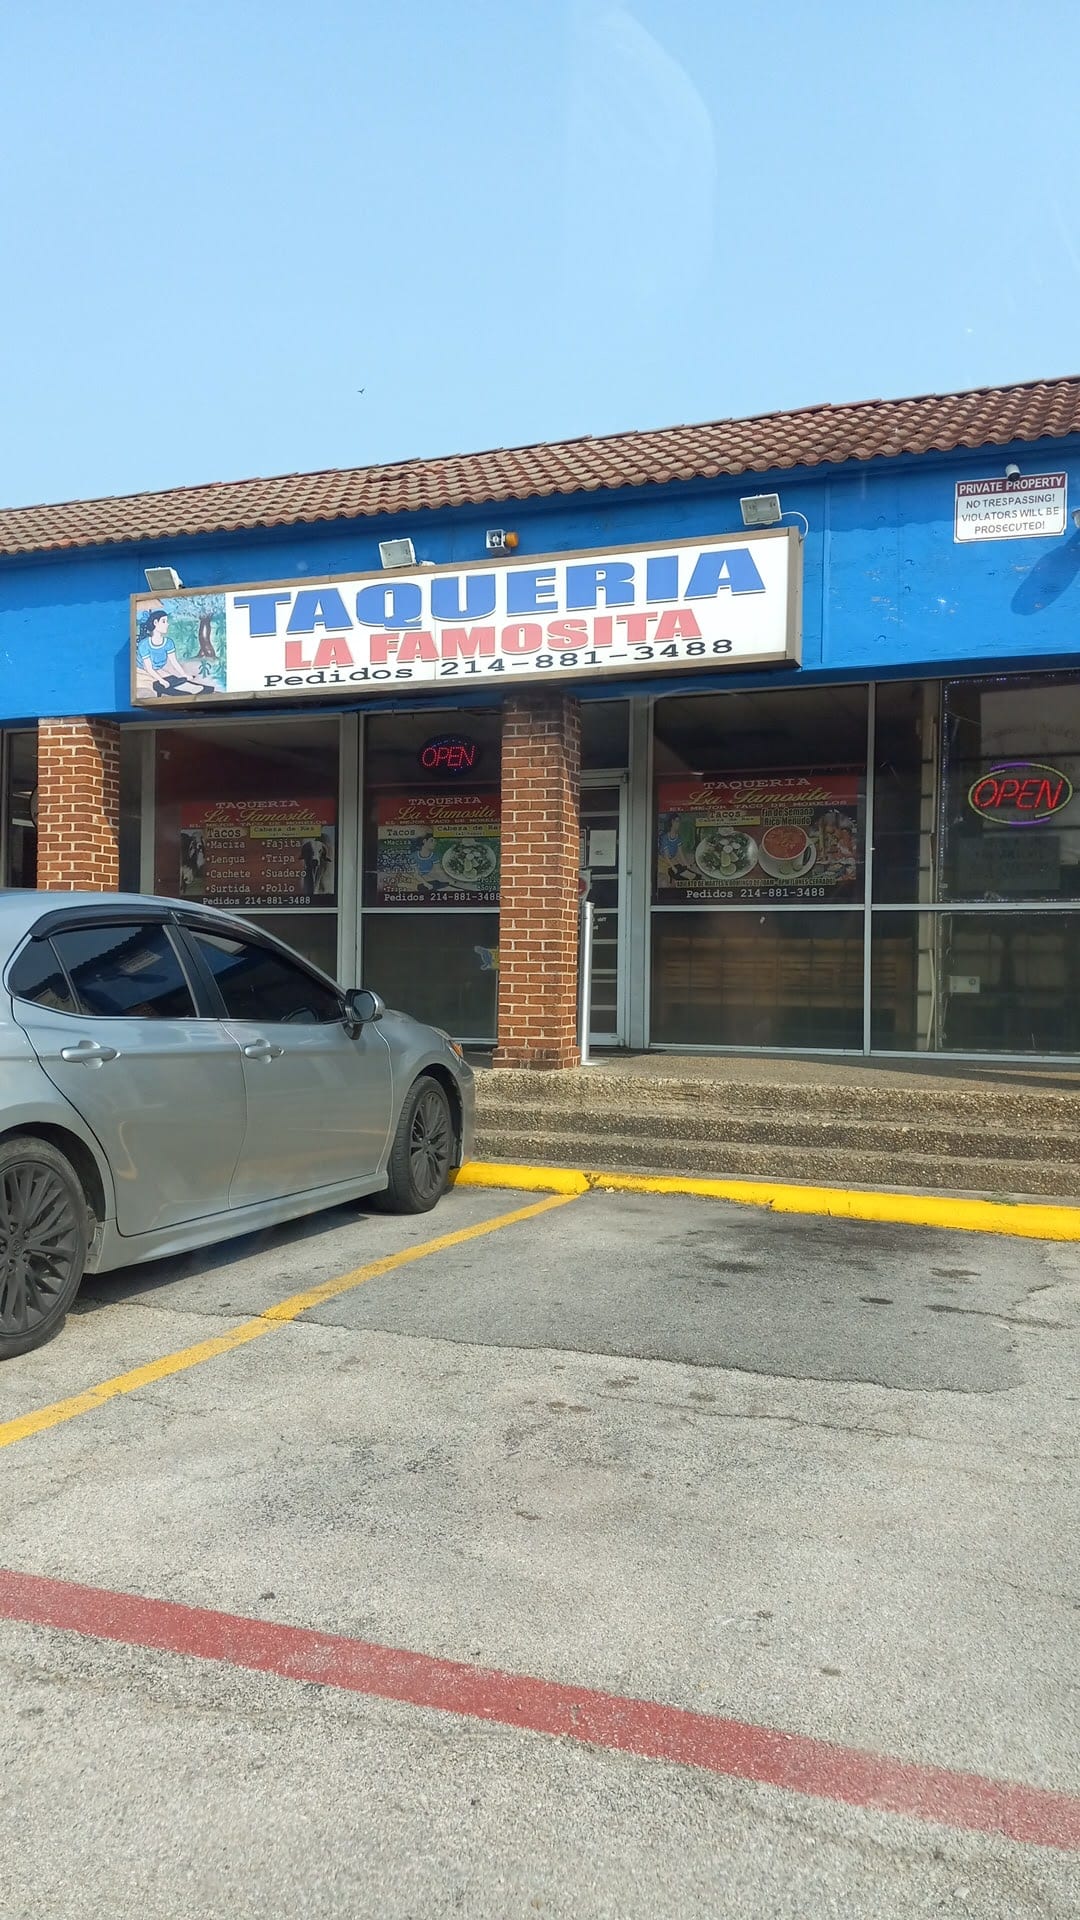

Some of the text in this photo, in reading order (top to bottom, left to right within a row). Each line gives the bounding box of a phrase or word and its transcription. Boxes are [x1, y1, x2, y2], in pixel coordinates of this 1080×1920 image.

[960, 476, 1063, 494] PRIVATE PROPERTY
[966, 494, 1055, 509] NO TRESPASSING!
[962, 506, 1060, 522] VIOLATORS WILL BE
[974, 521, 1045, 535] PROSECUTED!
[233, 548, 767, 638] TAQUERIA
[284, 608, 703, 672] LA FAMOSITA
[263, 639, 734, 689] Pedidos 214-881-3488
[422, 745, 476, 767] OPEN
[704, 778, 811, 790] TAQUERIA
[688, 790, 721, 805] La
[974, 778, 1063, 809] OPEN
[216, 800, 300, 809] TAQUERIA
[408, 796, 482, 806] TAQUERIA
[203, 809, 230, 823] La
[397, 806, 421, 820] La
[206, 828, 241, 839] Tacos
[387, 829, 416, 837] Tacos
[210, 840, 246, 849] Maciza
[266, 839, 301, 850] Fajita
[210, 855, 245, 865] Lengua
[266, 854, 295, 864] Tripa
[210, 869, 251, 878] Cachete
[266, 869, 307, 878] Suadero
[210, 884, 251, 893] Surtida
[266, 884, 295, 893] Pollo
[686, 888, 825, 898] Pedidos 214-881-3488
[203, 896, 311, 905] Pedidos 214-881-3488
[384, 893, 501, 902] Pedidos 214-881-3488
